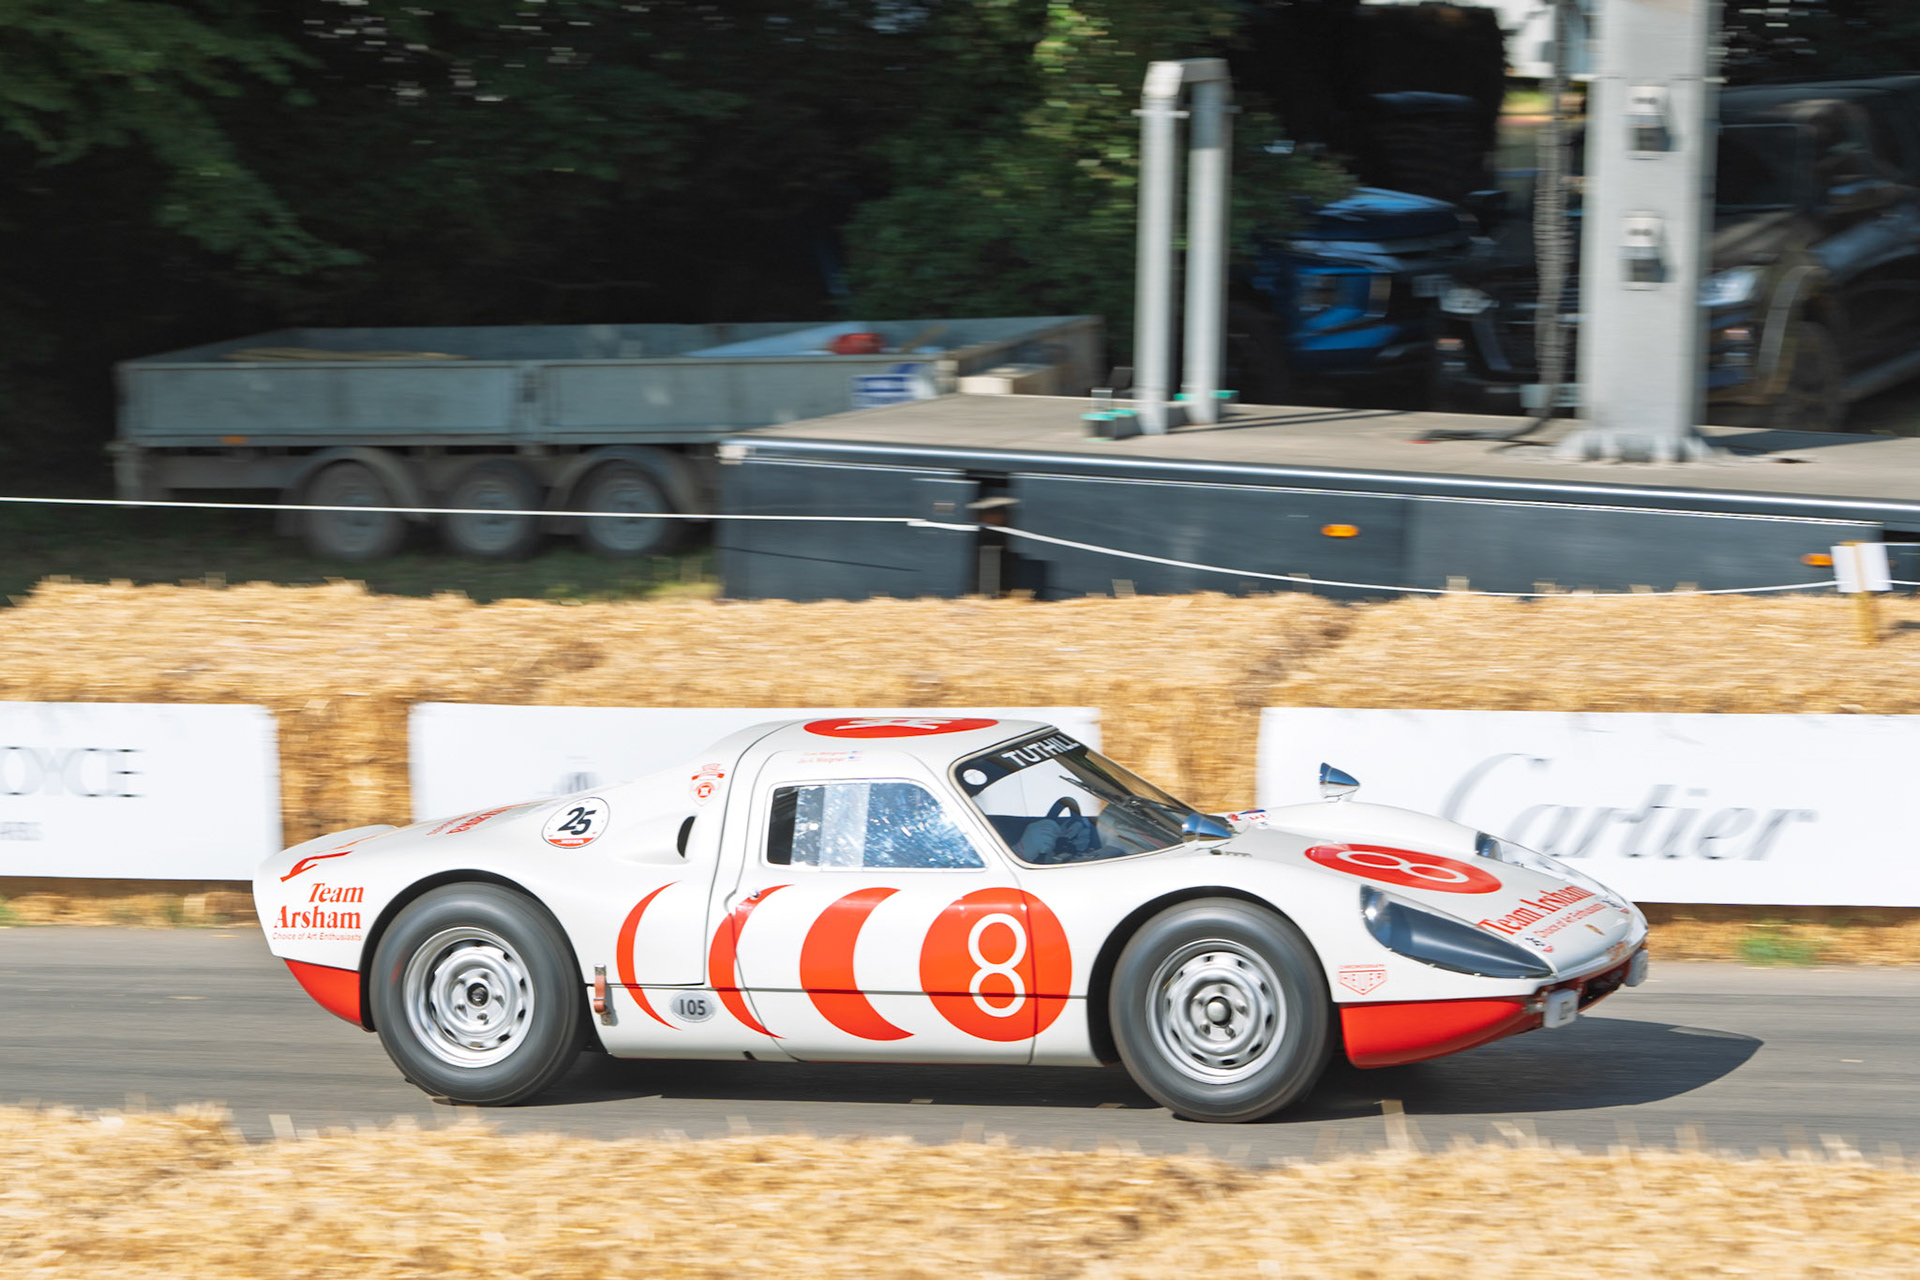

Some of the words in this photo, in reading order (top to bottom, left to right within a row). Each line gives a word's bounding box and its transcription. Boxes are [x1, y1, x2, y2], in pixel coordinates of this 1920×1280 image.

[1001, 734, 1081, 767] TUTHILL
[557, 806, 598, 836] 25
[1437, 752, 1819, 861] Cartier
[1335, 850, 1471, 884] 8
[308, 882, 364, 903] Team
[273, 904, 362, 930] Arsham
[1476, 907, 1545, 936] Team
[1518, 885, 1596, 916] Arsham
[967, 912, 1028, 1018] 8
[679, 999, 706, 1016] 105
